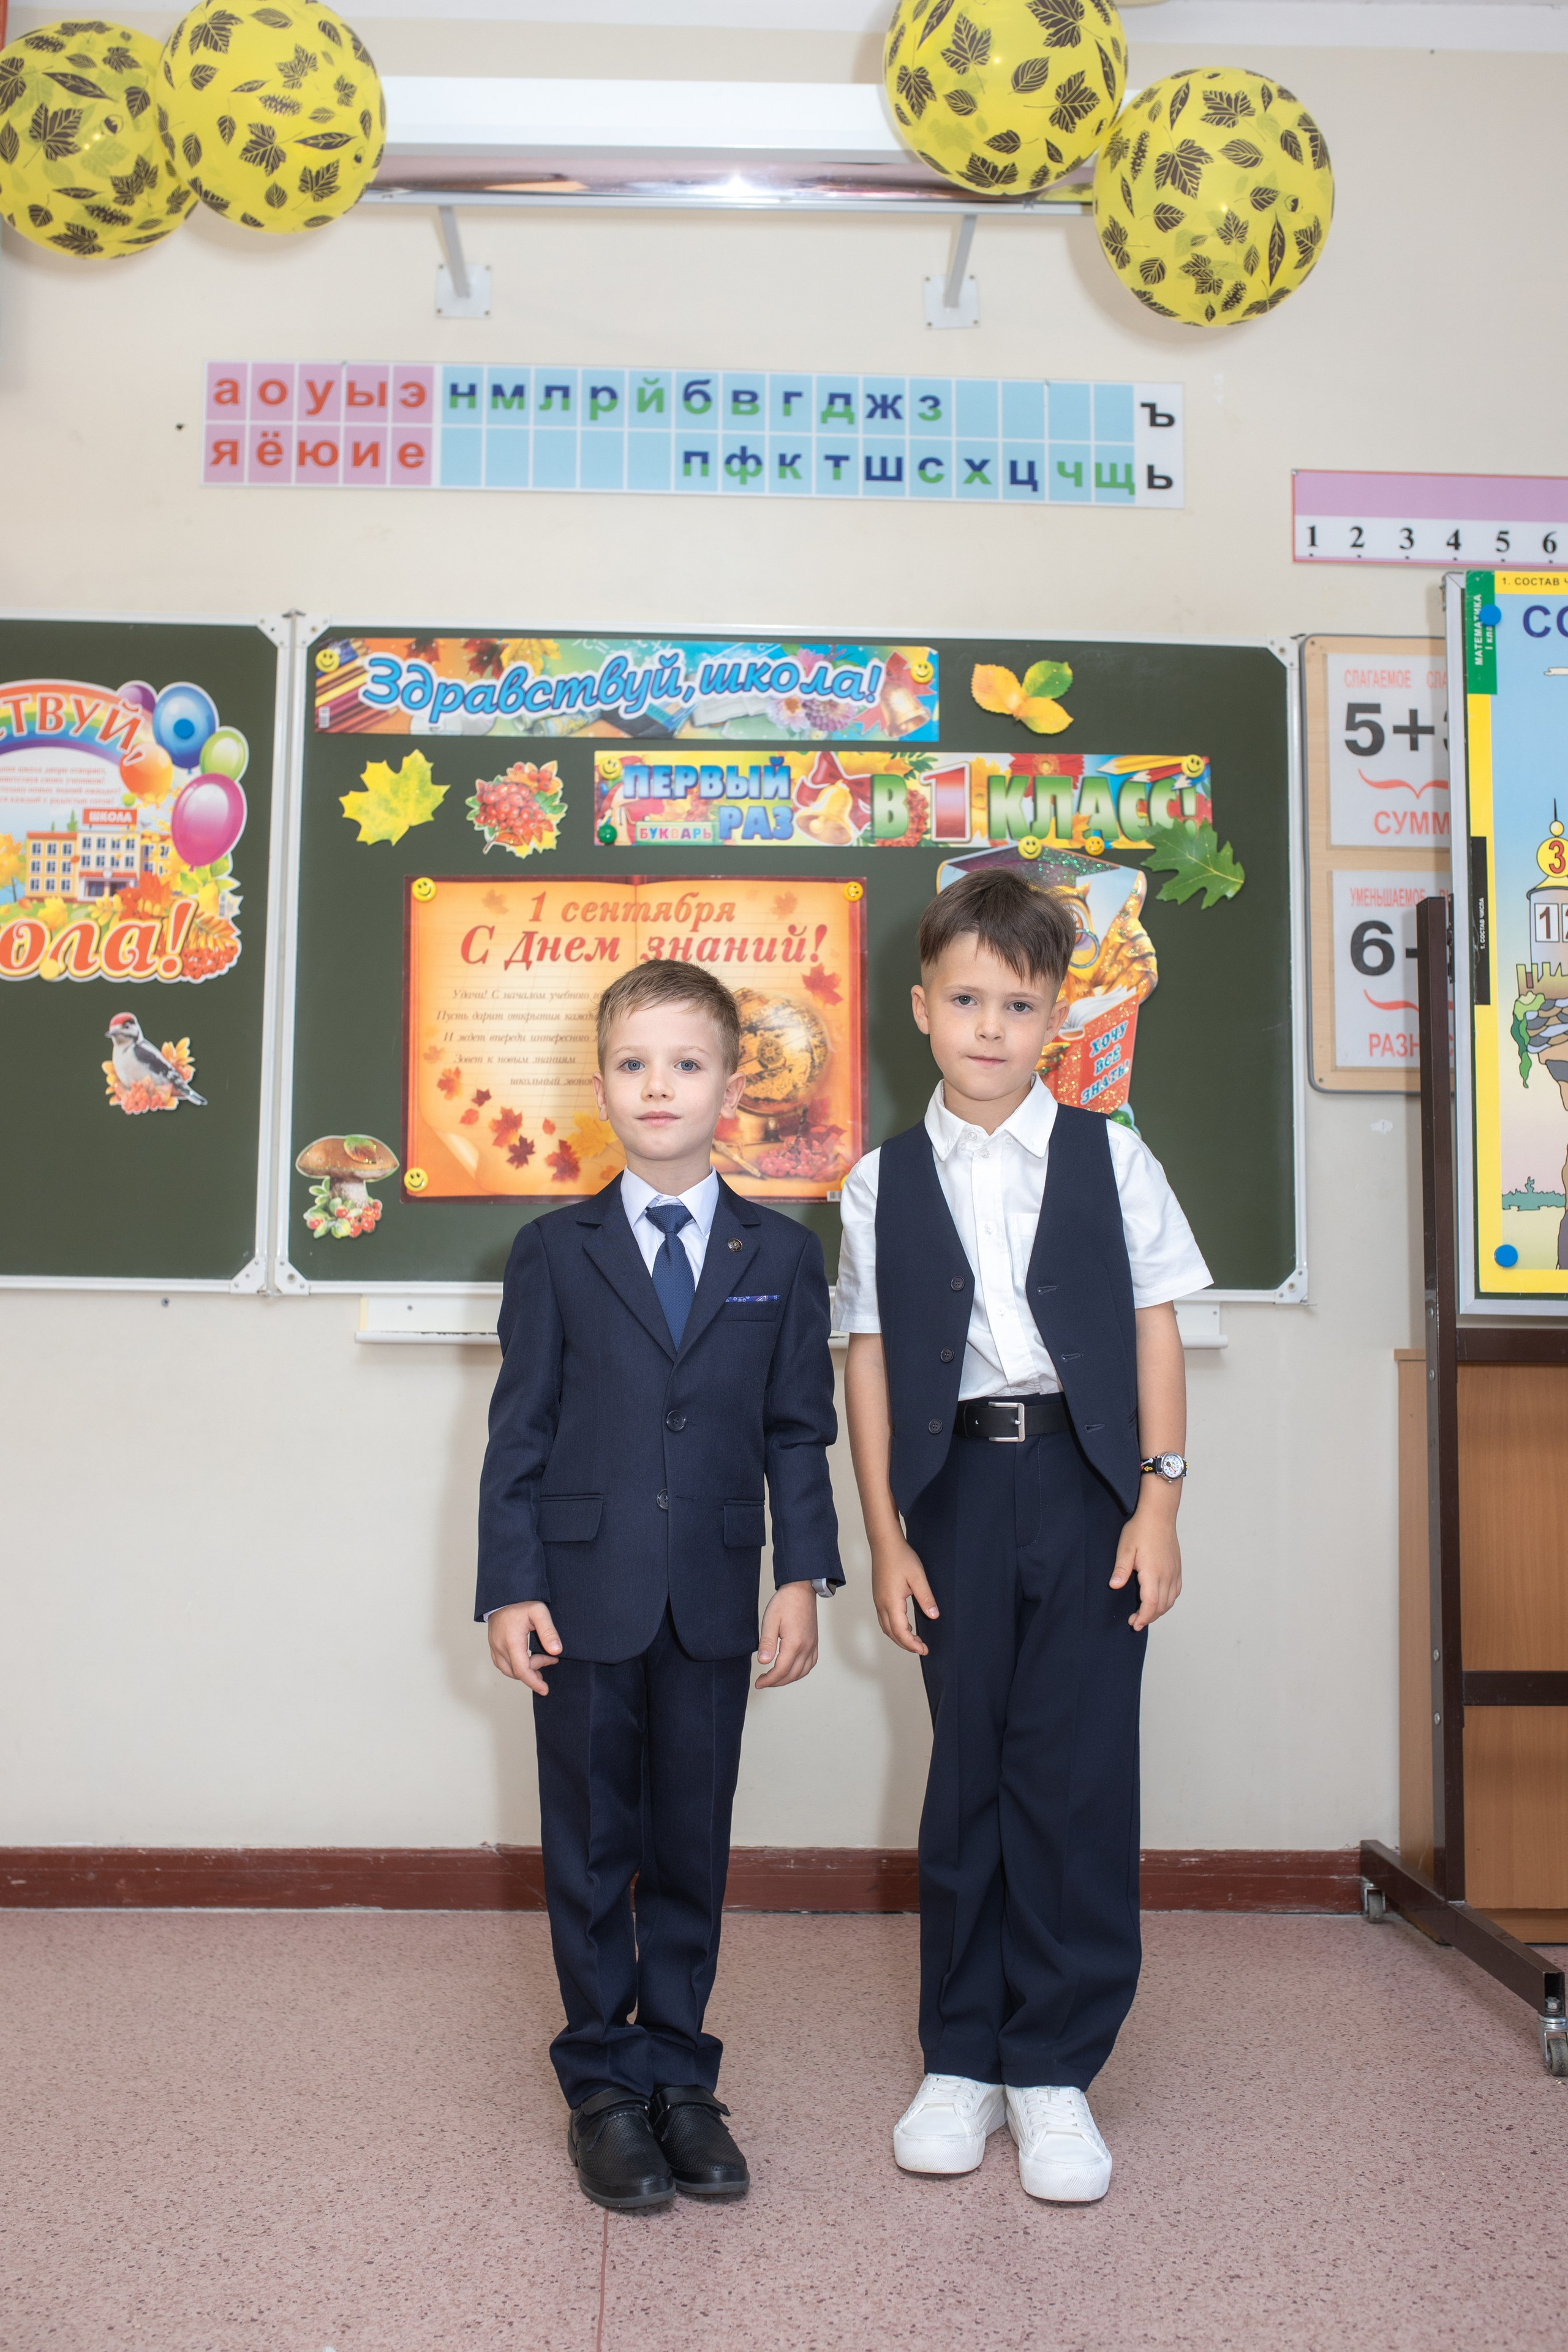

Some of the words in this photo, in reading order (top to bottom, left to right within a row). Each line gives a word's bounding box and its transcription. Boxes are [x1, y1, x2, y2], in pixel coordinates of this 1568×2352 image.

[213, 378, 239, 405] а
[258, 379, 288, 406] о
[306, 380, 334, 417] у
[346, 380, 387, 408] ы
[399, 381, 427, 409] э
[450, 382, 477, 409] н
[491, 383, 526, 410] м
[540, 384, 571, 410] л
[589, 385, 619, 420] р
[636, 377, 665, 414] й
[682, 379, 712, 414] б
[731, 389, 760, 415] в
[783, 390, 804, 417] г
[821, 392, 854, 424] д
[865, 393, 903, 420] ж
[919, 394, 941, 421] з
[1140, 402, 1175, 428] ъ
[211, 439, 239, 466] я
[256, 431, 284, 467] ё
[297, 440, 339, 468] ю
[352, 441, 380, 468] и
[397, 441, 425, 469] е
[683, 450, 710, 477] п
[724, 445, 763, 486] ф
[778, 453, 802, 478] к
[823, 454, 850, 480] т
[864, 455, 903, 483] ш
[918, 456, 944, 483] с
[963, 458, 990, 484] х
[1009, 459, 1039, 493] ц
[1056, 461, 1084, 488] ч
[1094, 462, 1135, 497] щ
[1147, 464, 1174, 490] ь
[1307, 525, 1318, 547] 1
[1350, 526, 1365, 549] 2
[1399, 527, 1415, 549] 3
[1446, 529, 1461, 551] 4
[1496, 530, 1510, 552] 5
[1542, 532, 1558, 553] 6
[1514, 578, 1560, 586] СОСТАВ
[363, 653, 696, 724] Здравствуй,
[699, 662, 883, 703] школа!
[1344, 669, 1412, 688] СЛАГАЕМОЕ
[622, 756, 791, 800] ПЕРВЫЙ
[88, 810, 133, 823] ШКОЛА
[870, 774, 910, 839] В
[919, 761, 972, 843] 1
[987, 774, 1197, 841] КЛАСС!
[639, 827, 712, 840] БУКВАРЬ
[718, 805, 794, 841] РАЗ
[1548, 840, 1566, 874] 3
[529, 891, 547, 922] 1
[560, 892, 736, 933] сентября
[1539, 906, 1551, 939] 1
[460, 924, 496, 965] С
[503, 930, 620, 971] Днем
[640, 924, 827, 963] знаний!
[549, 989, 590, 1002] учебного
[436, 1010, 469, 1023] Пусть
[472, 1011, 503, 1023] дарит
[507, 1012, 560, 1023] открытия
[443, 1031, 454, 1042] И
[530, 1034, 590, 1045] интересного
[1090, 1020, 1128, 1058] ХОЧУ
[532, 1056, 576, 1065] знаниям
[510, 1077, 561, 1086] школьный
[1080, 1059, 1130, 1104] ЗНАТЬ!
